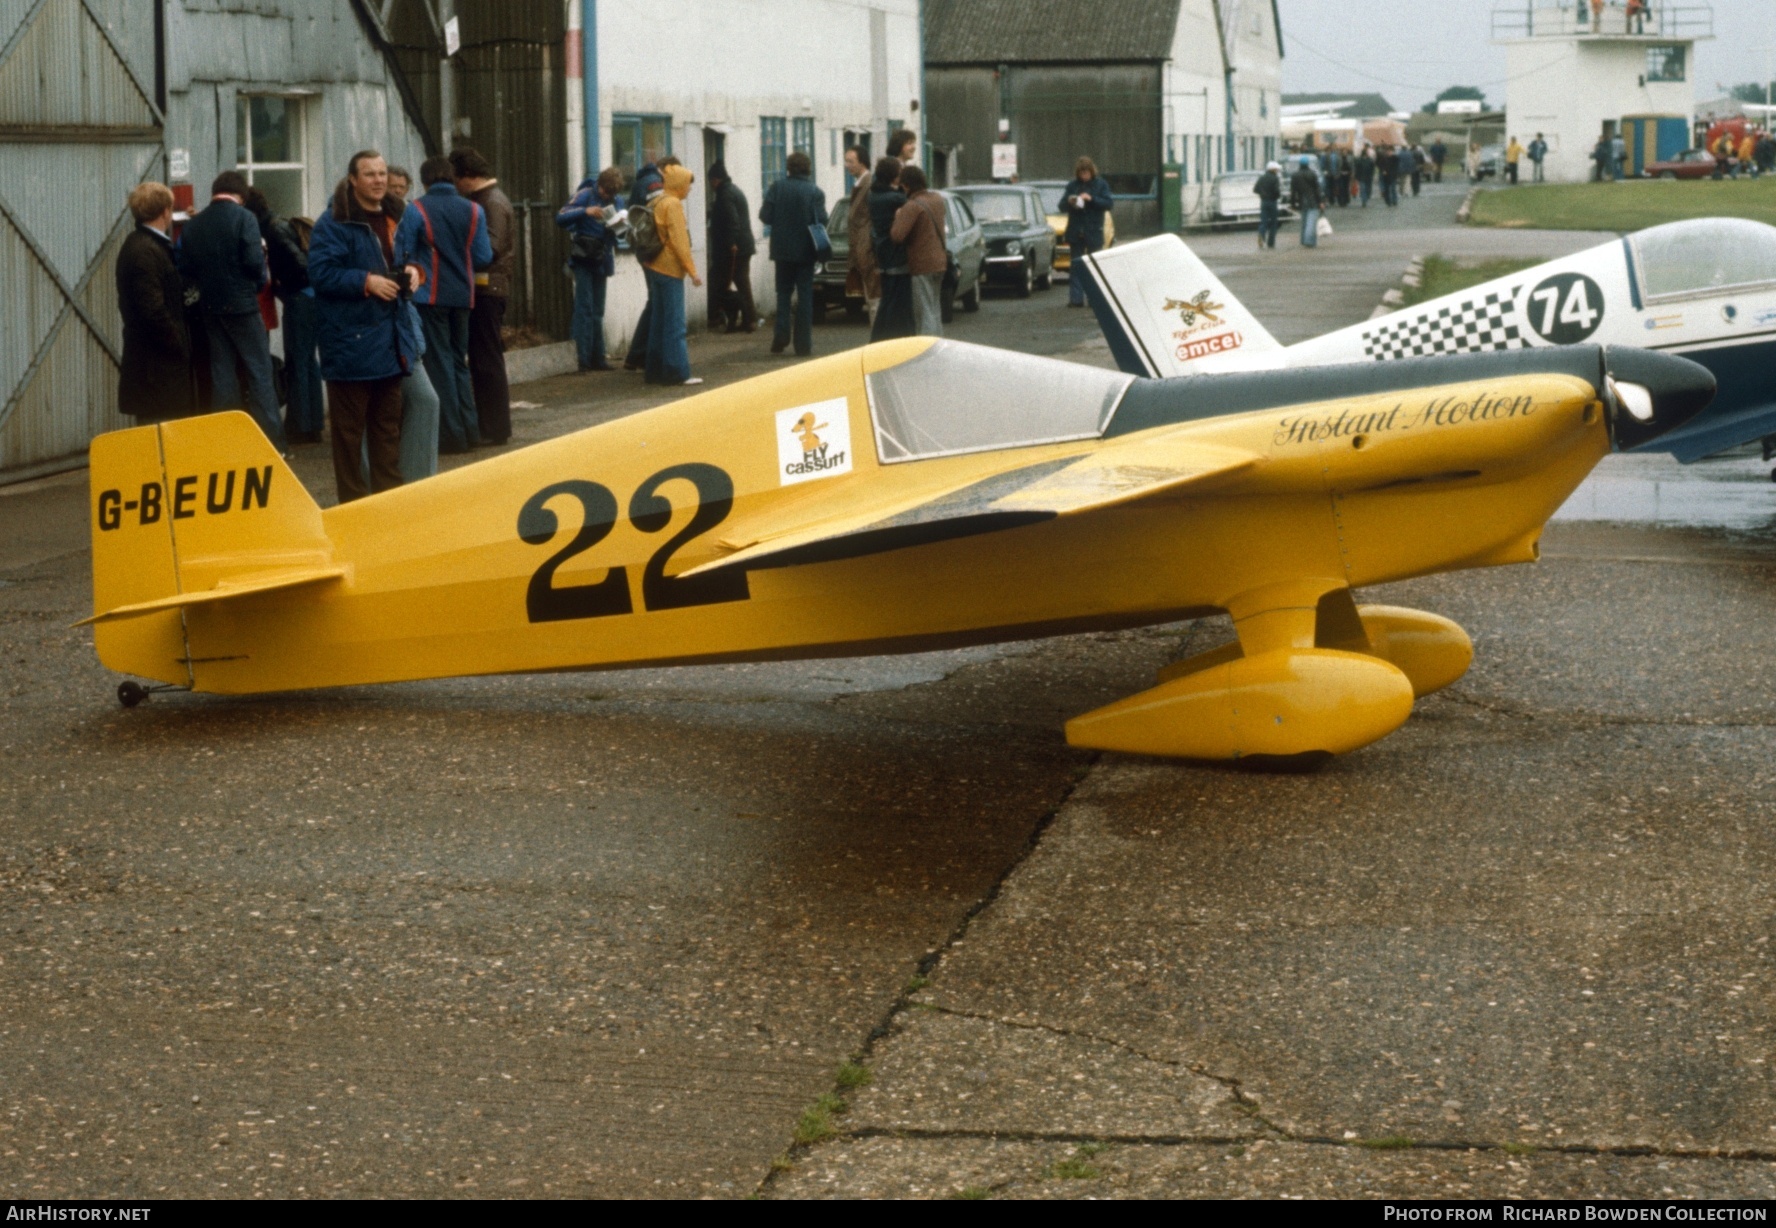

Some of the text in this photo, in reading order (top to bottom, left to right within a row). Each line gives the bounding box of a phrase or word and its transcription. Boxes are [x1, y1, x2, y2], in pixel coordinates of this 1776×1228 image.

[1533, 279, 1598, 335] 74
[1176, 332, 1241, 360] emcel
[1274, 391, 1538, 447] Instant Motion
[803, 442, 828, 462] FLY
[98, 465, 273, 532] G-BEUN
[517, 462, 751, 623] 22
